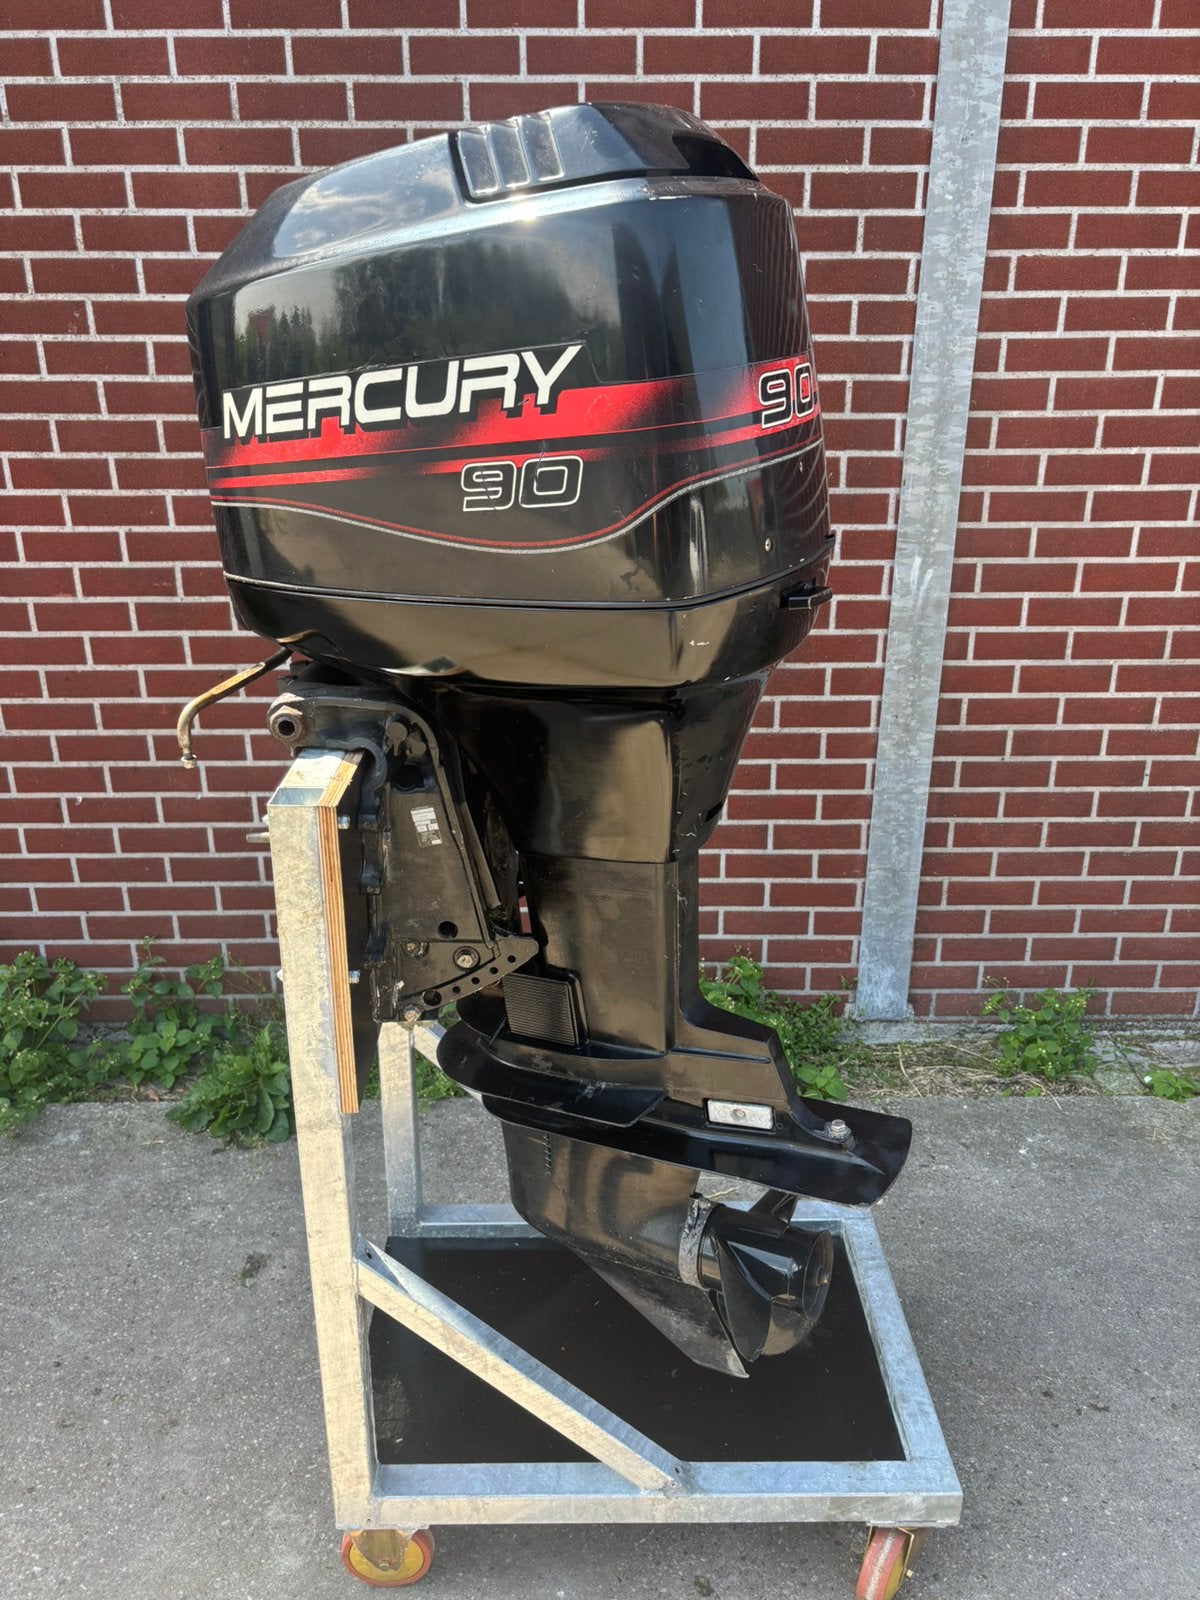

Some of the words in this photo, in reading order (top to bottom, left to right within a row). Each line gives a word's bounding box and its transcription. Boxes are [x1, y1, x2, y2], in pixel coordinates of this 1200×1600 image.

[222, 344, 583, 440] MERCURY
[758, 362, 815, 429] 90
[460, 455, 584, 512] 90
